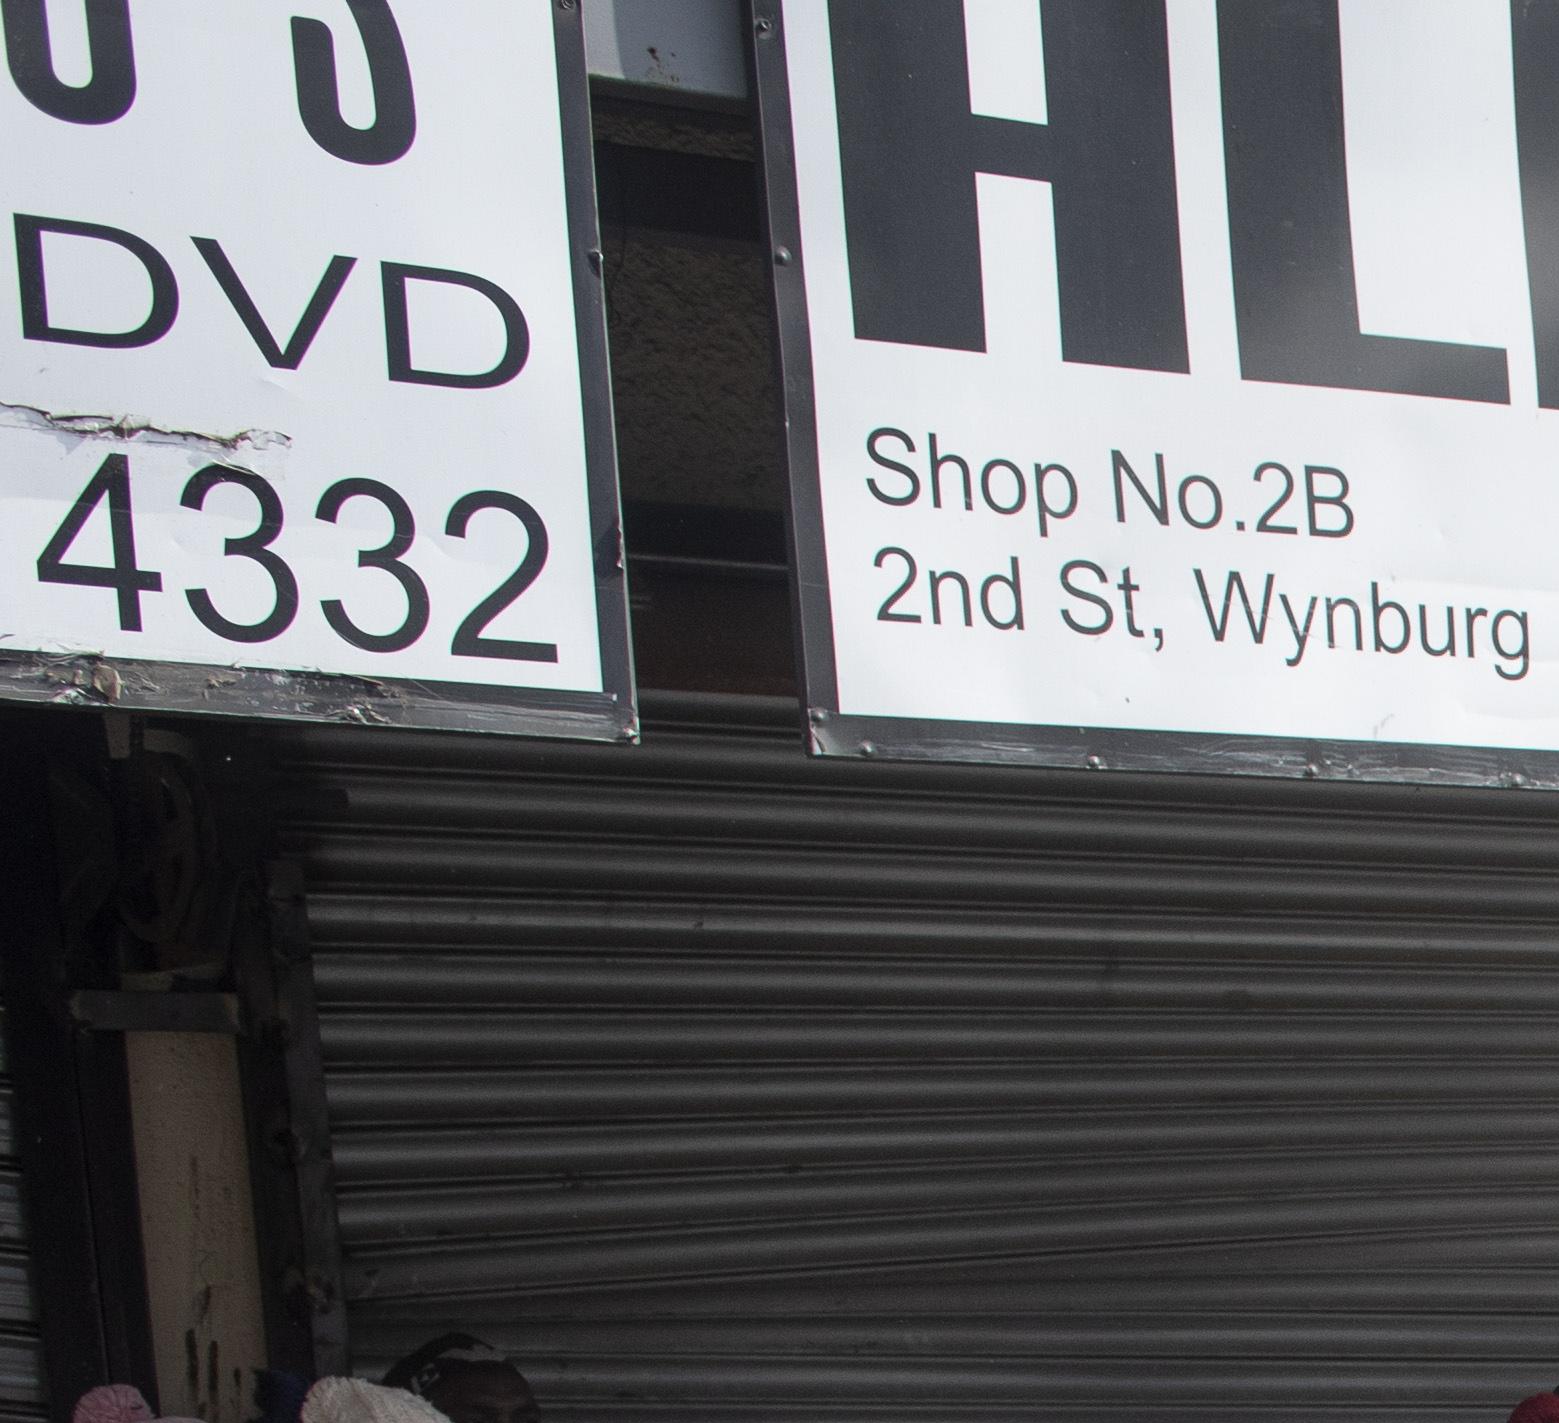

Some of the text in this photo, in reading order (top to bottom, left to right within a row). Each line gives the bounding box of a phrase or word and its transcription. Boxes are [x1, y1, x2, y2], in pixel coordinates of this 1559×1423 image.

[13, 212, 530, 389] DVD
[36, 453, 558, 664] 4332
[865, 427, 1356, 539] Shop No.2B
[874, 548, 1531, 682] 2nd St, Wynburg
